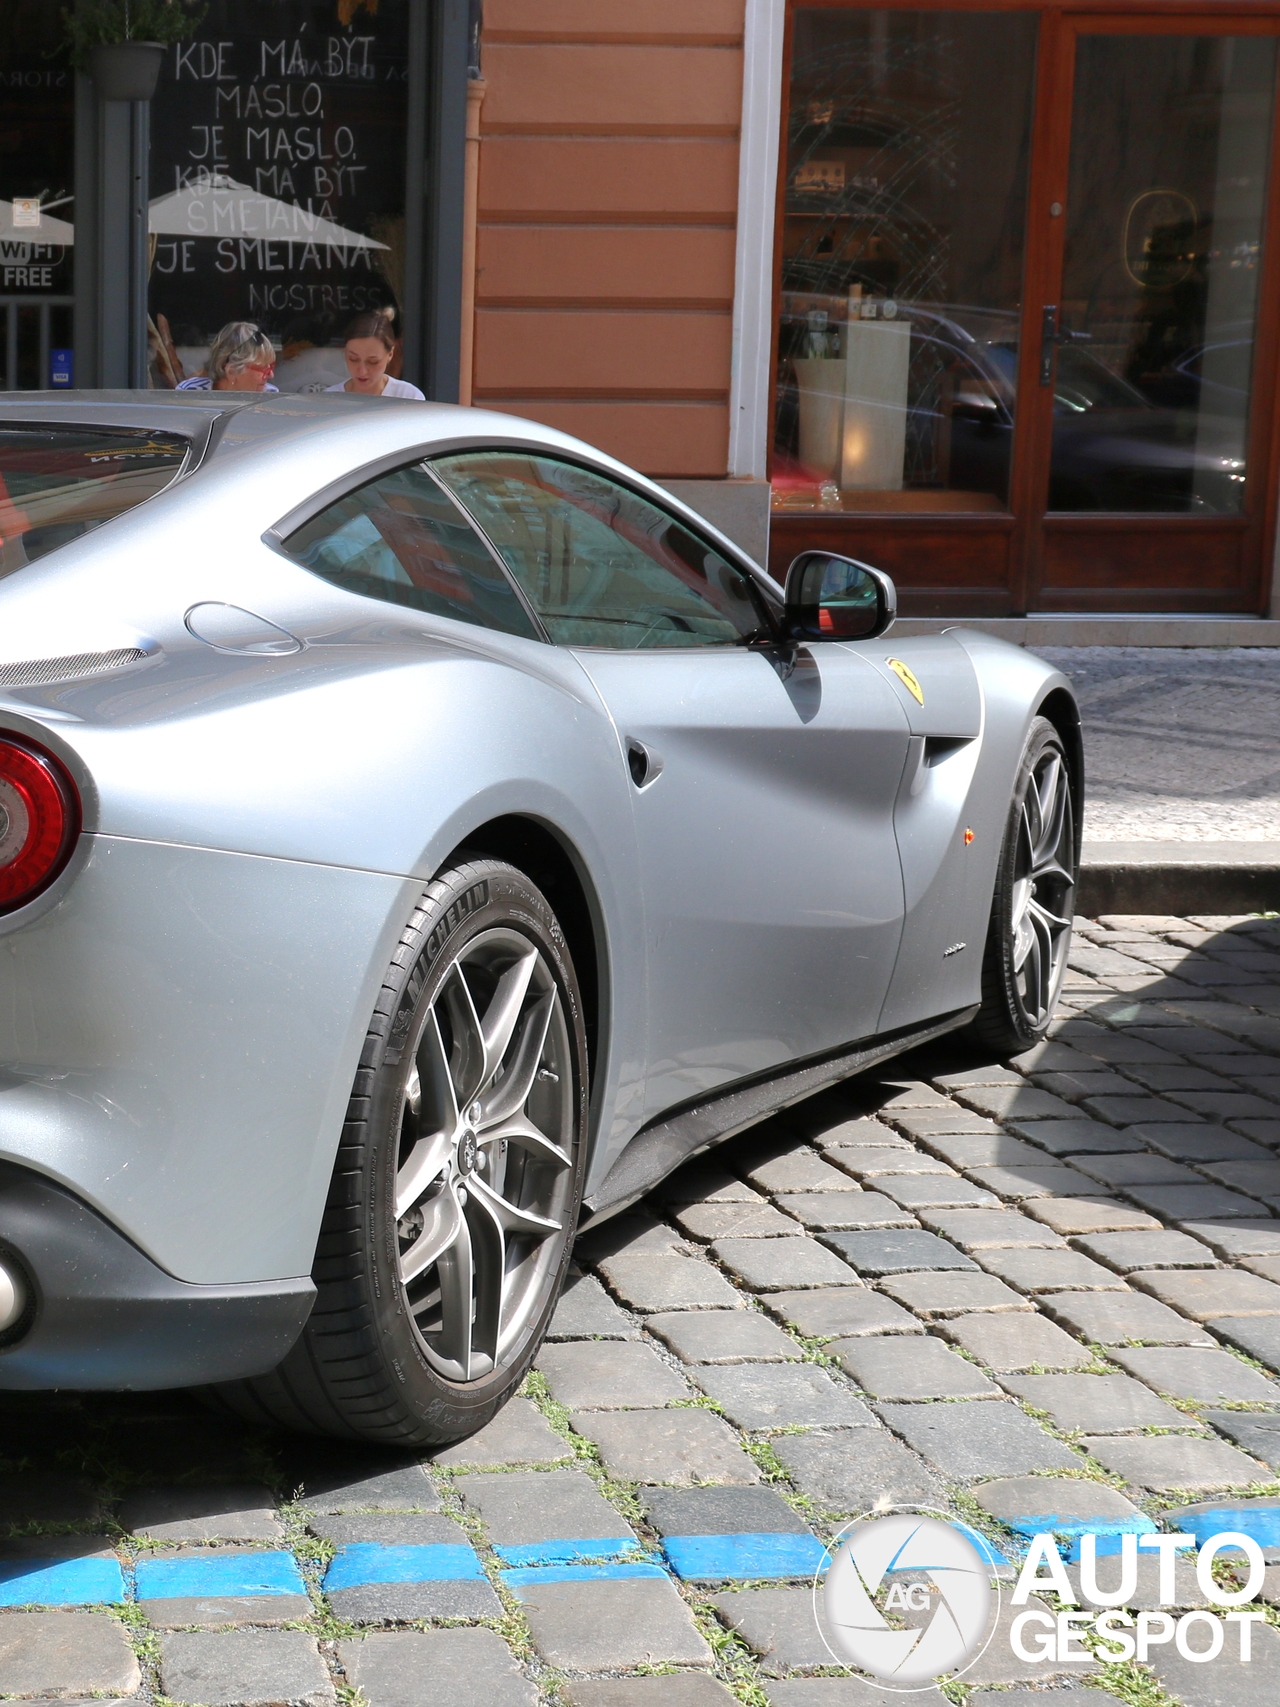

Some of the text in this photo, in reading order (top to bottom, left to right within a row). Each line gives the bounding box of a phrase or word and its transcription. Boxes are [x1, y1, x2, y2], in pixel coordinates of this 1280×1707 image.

[175, 42, 237, 80] KDE
[261, 22, 306, 77] MÁ
[188, 125, 228, 161] JE
[174, 164, 230, 198] KDE
[255, 161, 299, 197] MÁ
[156, 240, 196, 273] JE
[4, 266, 52, 287] FREE
[406, 883, 485, 1003] MICHELIN
